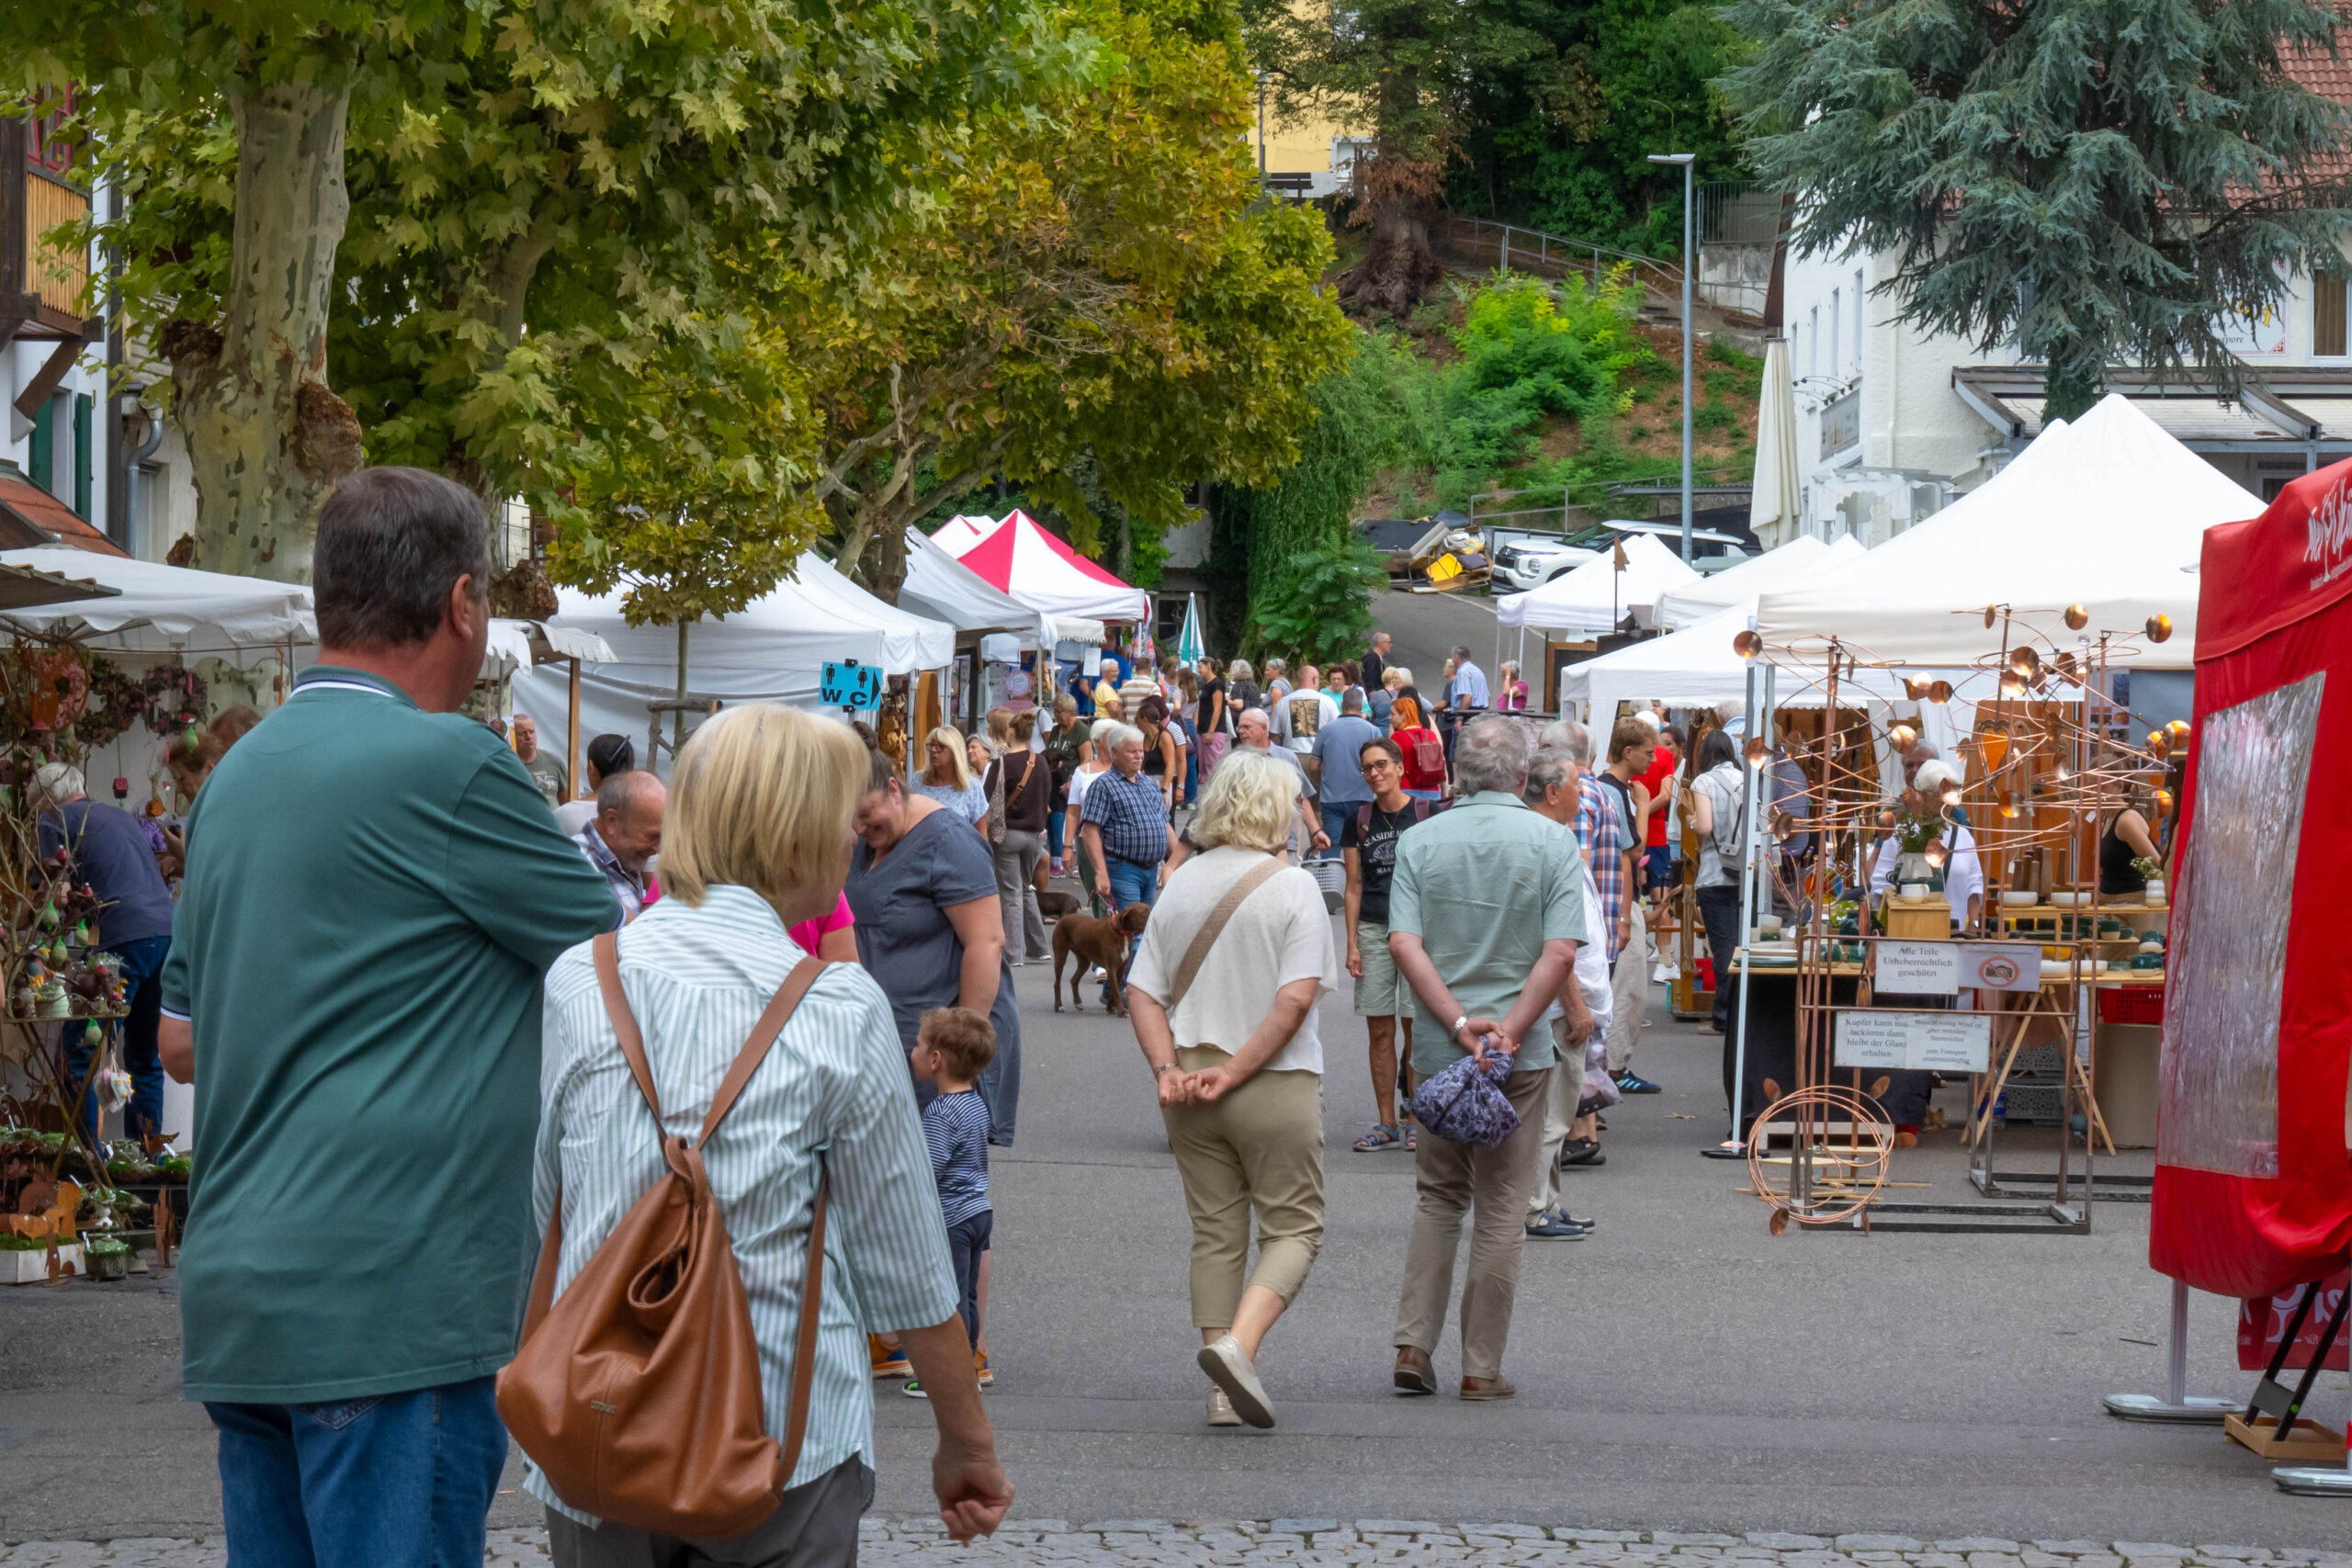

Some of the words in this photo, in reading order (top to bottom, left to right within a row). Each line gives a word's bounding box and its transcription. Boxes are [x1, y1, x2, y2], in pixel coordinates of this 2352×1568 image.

[1363, 830, 1395, 847] SEASIDE
[1898, 947, 1917, 955] Alle
[1918, 947, 1939, 955] Teile
[1883, 956, 1953, 967] Urheberrechtlich
[1897, 969, 1937, 978] geschützt
[1845, 1018, 1871, 1027] Kupfer
[1874, 1018, 1893, 1027] kann
[1850, 1028, 1885, 1037] lackieren
[1847, 1038, 1869, 1046] bleibt
[1870, 1039, 1883, 1047] der
[1861, 1049, 1893, 1057] erhalten
